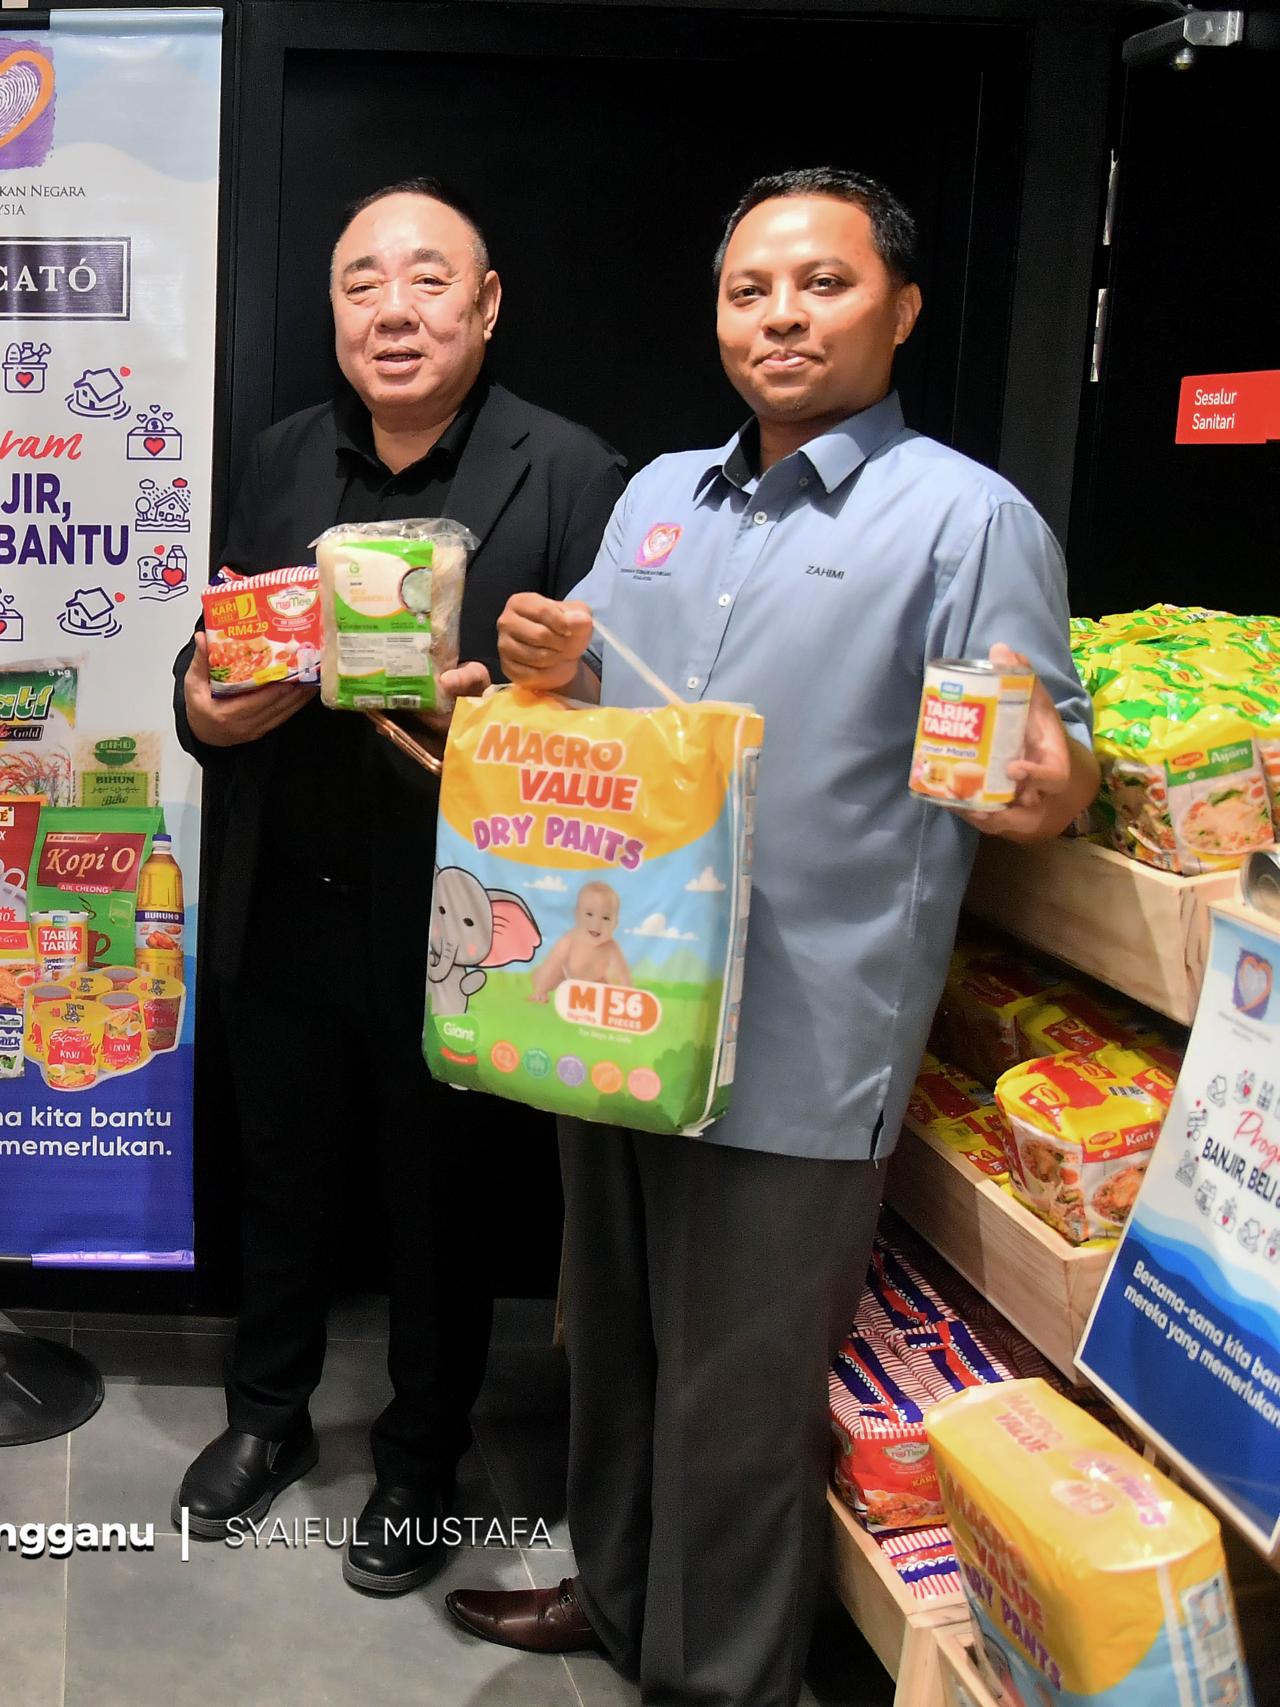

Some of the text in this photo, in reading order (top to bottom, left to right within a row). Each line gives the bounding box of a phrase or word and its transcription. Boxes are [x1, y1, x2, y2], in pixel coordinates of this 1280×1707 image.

[31, 185, 86, 198] NEGARA
[1194, 388, 1237, 406] Sesalur
[1192, 412, 1236, 430] Sanitari
[805, 565, 845, 580] ZAHIMI
[211, 603, 237, 617] KARI
[227, 621, 269, 637] RM4.29
[926, 698, 979, 725] TARIK
[13, 727, 40, 738] Gold
[924, 716, 978, 739] TARIK
[476, 722, 625, 773] MACRO
[1211, 746, 1249, 764] Ayam
[95, 775, 135, 785] BIHUN
[520, 767, 639, 812] VALUE
[472, 814, 646, 872] DRY PANTS
[45, 846, 136, 878] Kopi O
[41, 941, 78, 952] TARIK
[42, 930, 79, 941] TARIK
[569, 985, 598, 1012] M
[608, 991, 643, 1018] 56
[443, 1021, 475, 1042] Giant
[31, 1105, 82, 1128] kita
[91, 1107, 172, 1128] bantu
[1124, 1129, 1154, 1146] Kari
[1233, 1111, 1280, 1172] Prog
[1201, 1136, 1278, 1203] BANJIR, BELI
[1124, 1285, 1168, 1330] mereka
[1166, 1320, 1201, 1360] yang
[1132, 1260, 1280, 1397] Bersama-sama kita ban
[994, 1412, 1050, 1453] VALUE
